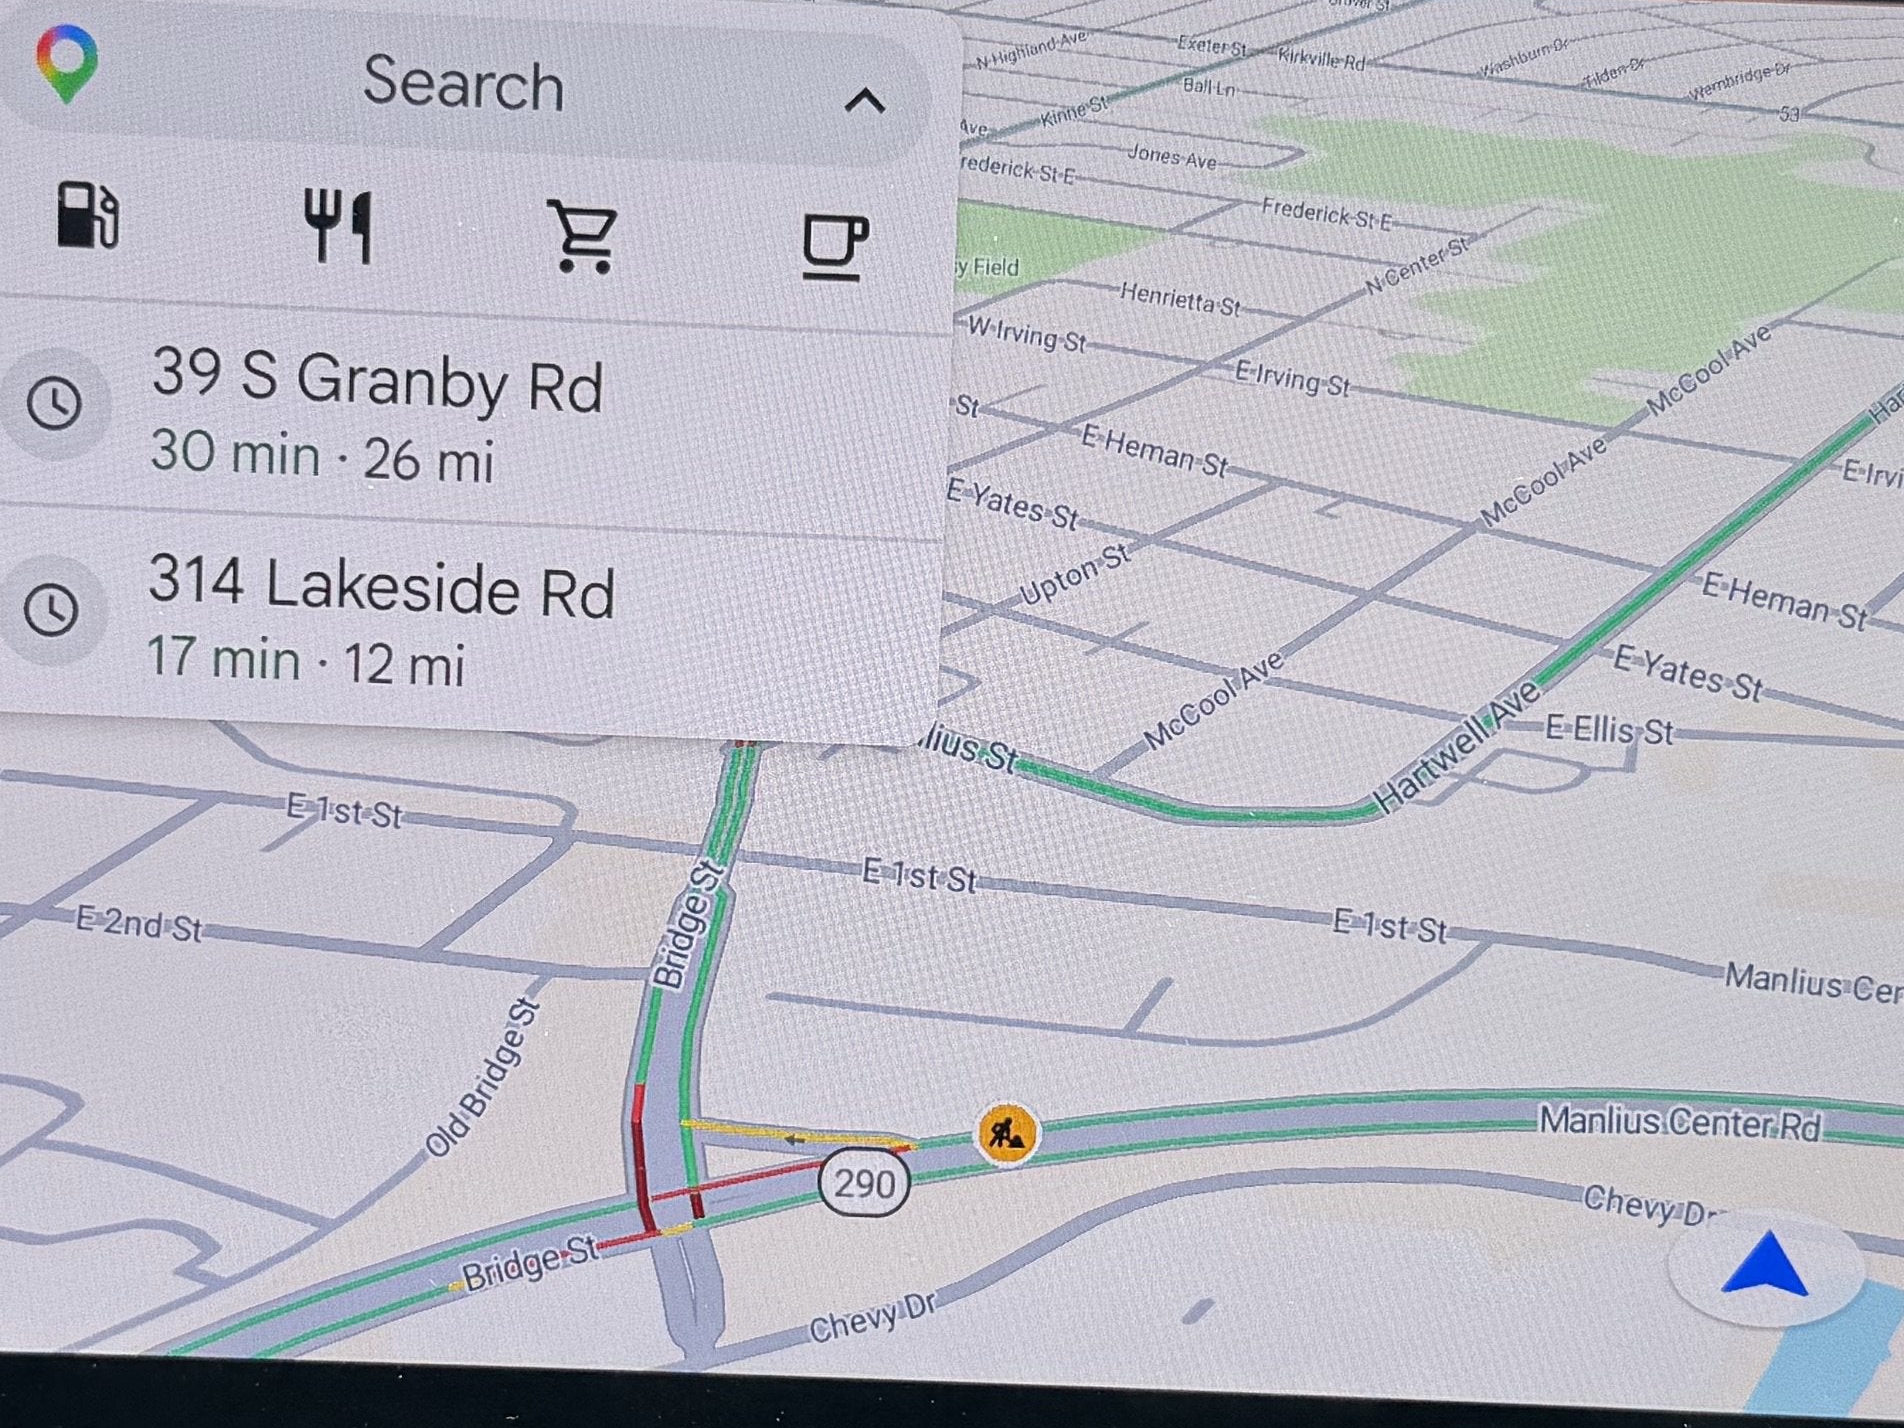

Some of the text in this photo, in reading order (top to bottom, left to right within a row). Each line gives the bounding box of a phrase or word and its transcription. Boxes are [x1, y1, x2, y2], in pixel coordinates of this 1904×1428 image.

[976, 31, 1088, 69] N Highland Ave
[1177, 34, 1246, 57] Exeter St
[1278, 47, 1366, 72] Kirkville Rd
[362, 53, 564, 112] Search
[1041, 96, 1107, 128] Kinne St
[1128, 143, 1217, 170] Jones Ave
[1262, 197, 1392, 232] Frederick St E
[974, 258, 1019, 277] Field
[1365, 238, 1470, 296] N Center St
[1120, 282, 1241, 317] Henrietta St
[968, 315, 1087, 353] W Irving St
[153, 345, 603, 421] 39 S Granby Rd
[1235, 360, 1351, 398] E Irving St
[1646, 323, 1772, 417] McCool Ave
[955, 394, 980, 418] St
[151, 428, 493, 483] 30 min 26 mi
[1082, 424, 1229, 478] E Heman St
[1843, 460, 1859, 482] E
[1480, 436, 1607, 528] McCool Ave
[946, 477, 1080, 532] E Yates St
[149, 552, 614, 618] 314 Lakeside Rd
[1019, 542, 1132, 608] Upton St
[1702, 571, 1868, 632] E Heman St
[148, 634, 464, 687] 17 min 12 mi
[1614, 644, 1764, 704] E Yates St
[1144, 650, 1285, 751] McCool Ave
[1372, 679, 1541, 815] Hartwell Ave
[1546, 713, 1674, 746] E Ellis St
[287, 793, 402, 829] E 1st St
[862, 857, 977, 895] E 1st St
[76, 905, 202, 943] E 2nd St
[654, 859, 725, 989] Bridge St
[1333, 908, 1447, 944] E 1st St
[1725, 961, 1842, 999] Manlius
[425, 996, 541, 1159] Old Bridge St
[1539, 1105, 1821, 1143] Manlius Center Rd
[835, 1169, 896, 1200] 290
[1584, 1184, 1674, 1229] Chevy
[462, 1236, 599, 1293] Bridge St
[810, 1291, 938, 1343] Chevy Dr
